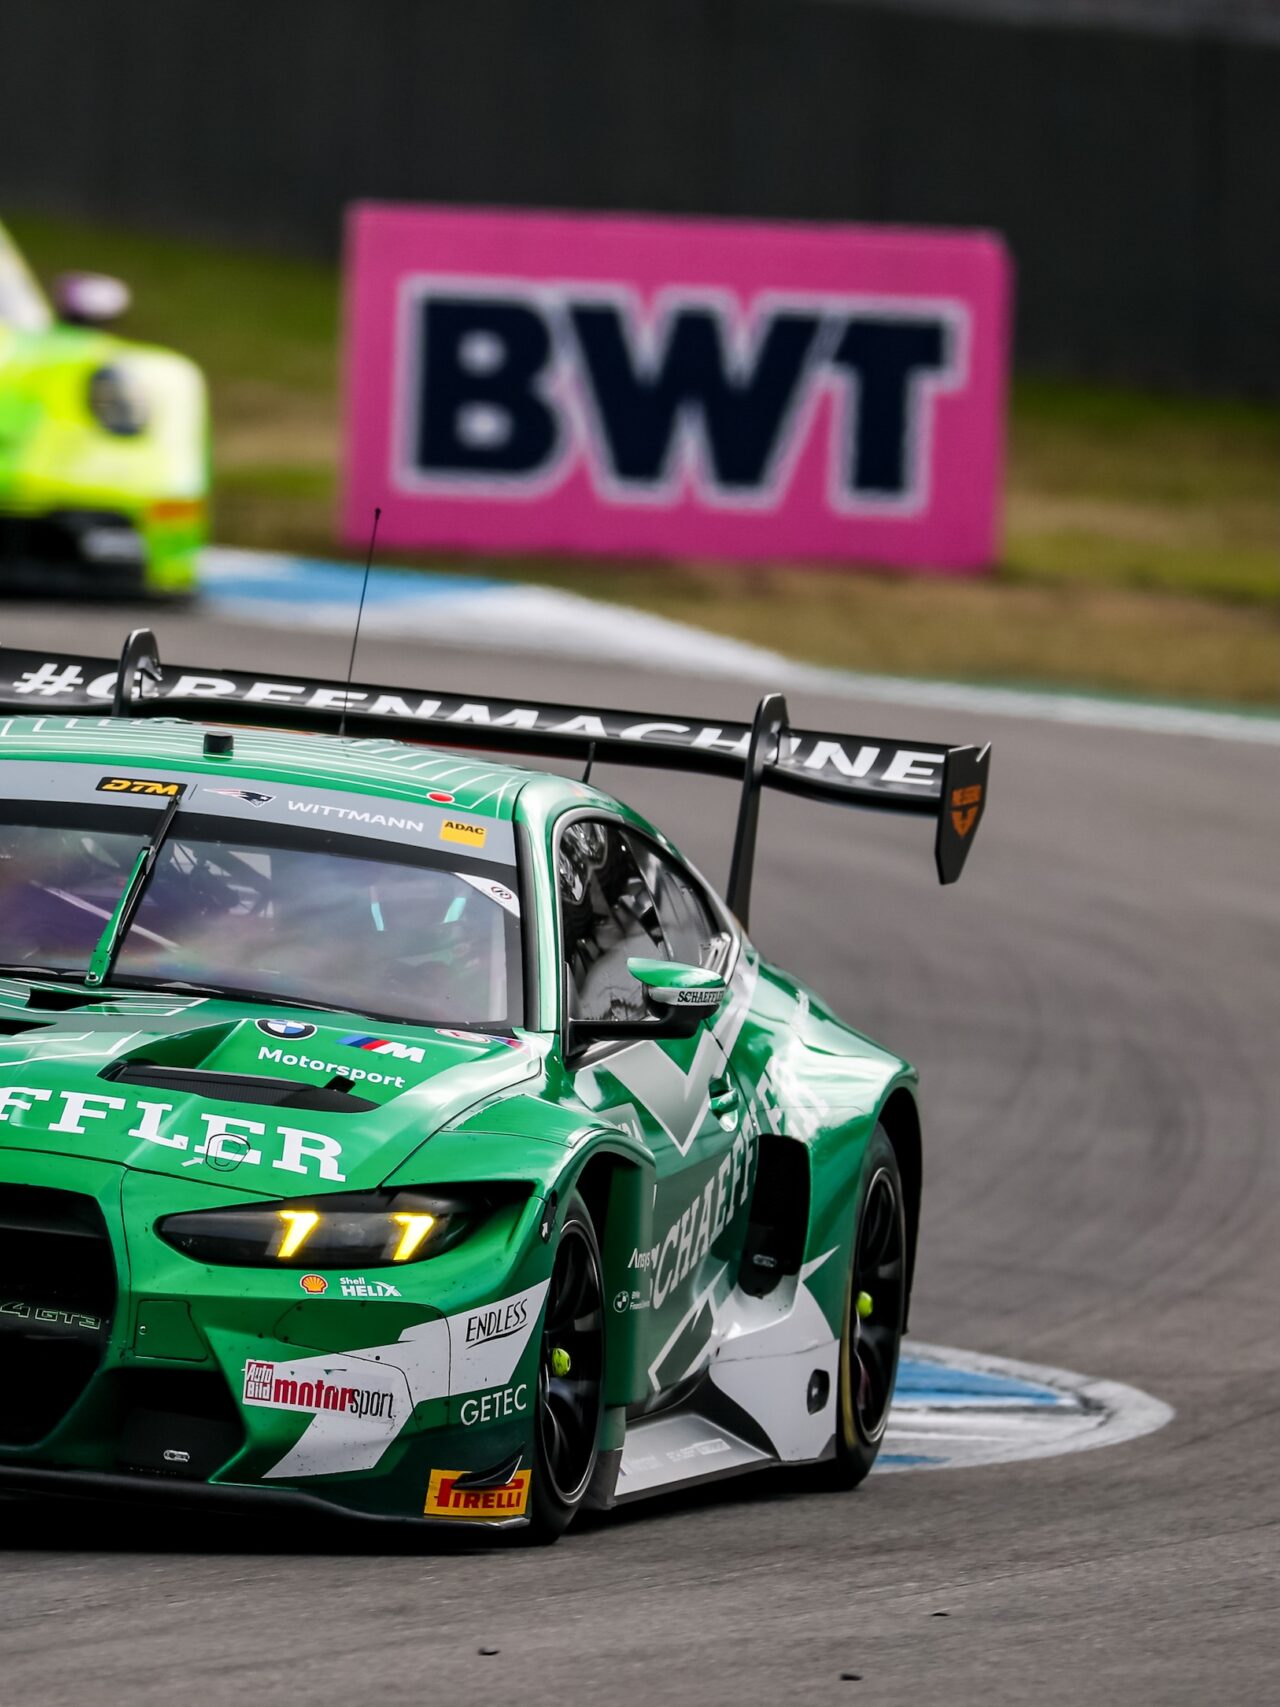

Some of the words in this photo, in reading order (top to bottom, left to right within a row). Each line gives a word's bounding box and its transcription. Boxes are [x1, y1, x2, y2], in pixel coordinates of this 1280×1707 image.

[408, 290, 952, 500] BWT
[102, 779, 179, 795] DTM
[286, 799, 424, 832] WITTMANN
[443, 820, 485, 836] ADAC
[257, 1046, 407, 1089] Motorsport
[339, 1277, 365, 1286] Shell
[341, 1281, 402, 1297] HELIX
[35, 1308, 101, 1330] GT3
[465, 1298, 528, 1344] ENDLESS
[247, 1363, 273, 1382] Auto
[246, 1382, 271, 1400] Bild
[460, 1384, 528, 1426] GETEC
